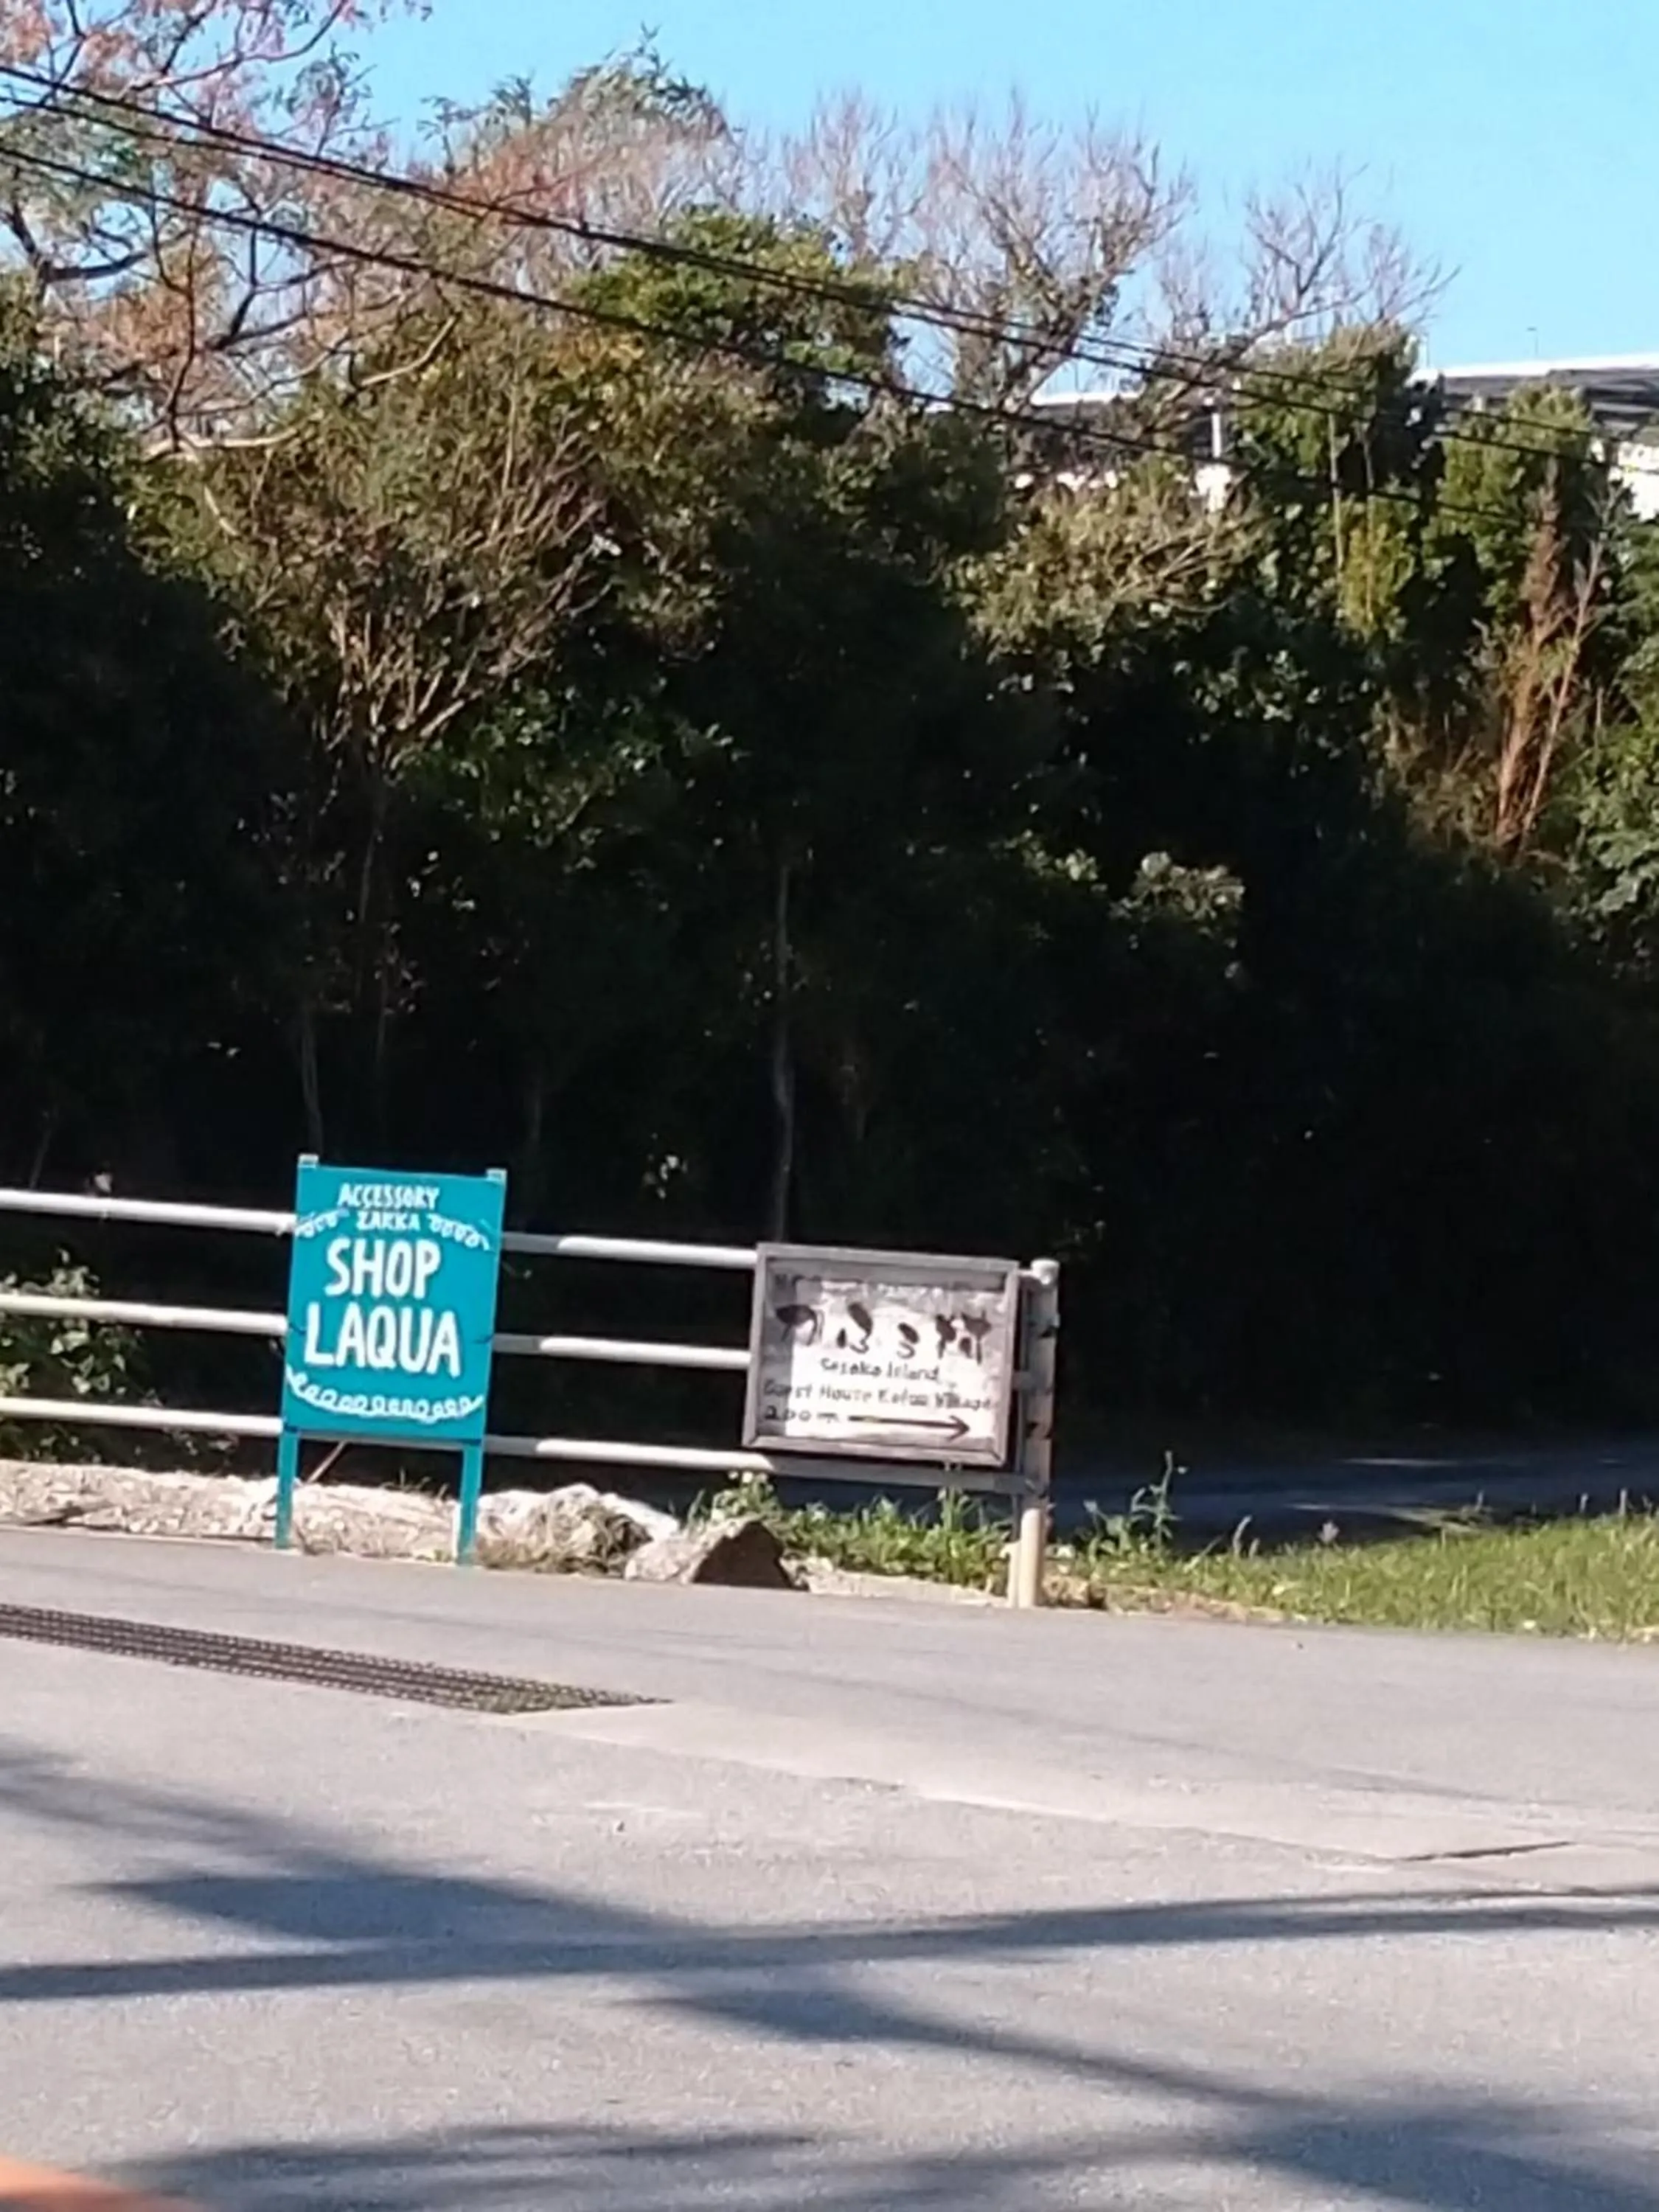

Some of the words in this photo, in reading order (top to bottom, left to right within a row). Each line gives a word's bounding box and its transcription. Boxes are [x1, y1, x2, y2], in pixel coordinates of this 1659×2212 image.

[337, 1183, 440, 1210] ACCESSORY
[324, 1237, 441, 1299] SHOP
[303, 1301, 461, 1379] LAQUA
